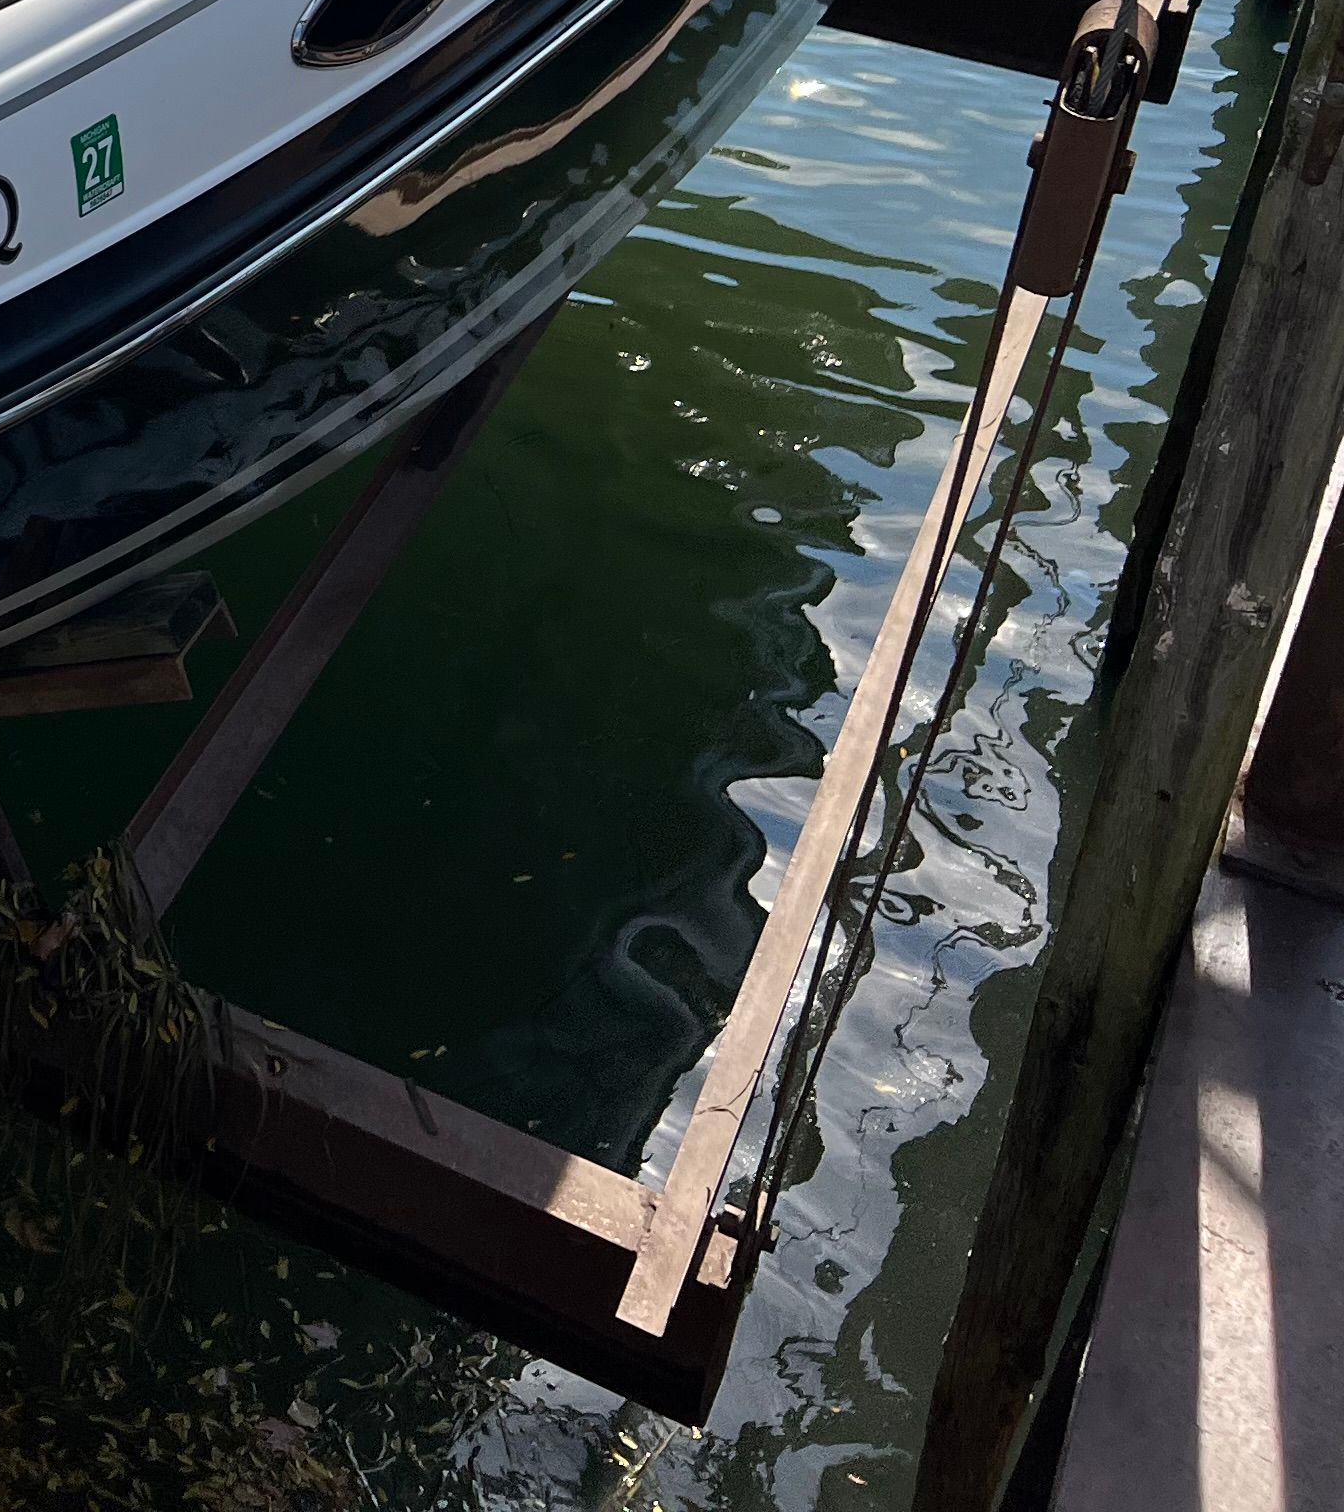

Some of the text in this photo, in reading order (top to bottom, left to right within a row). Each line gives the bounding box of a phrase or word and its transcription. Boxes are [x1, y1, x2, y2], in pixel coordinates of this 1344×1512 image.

[79, 121, 111, 144] MICHIGAN
[81, 135, 114, 191] 27
[82, 173, 121, 202] WATERCRAFT
